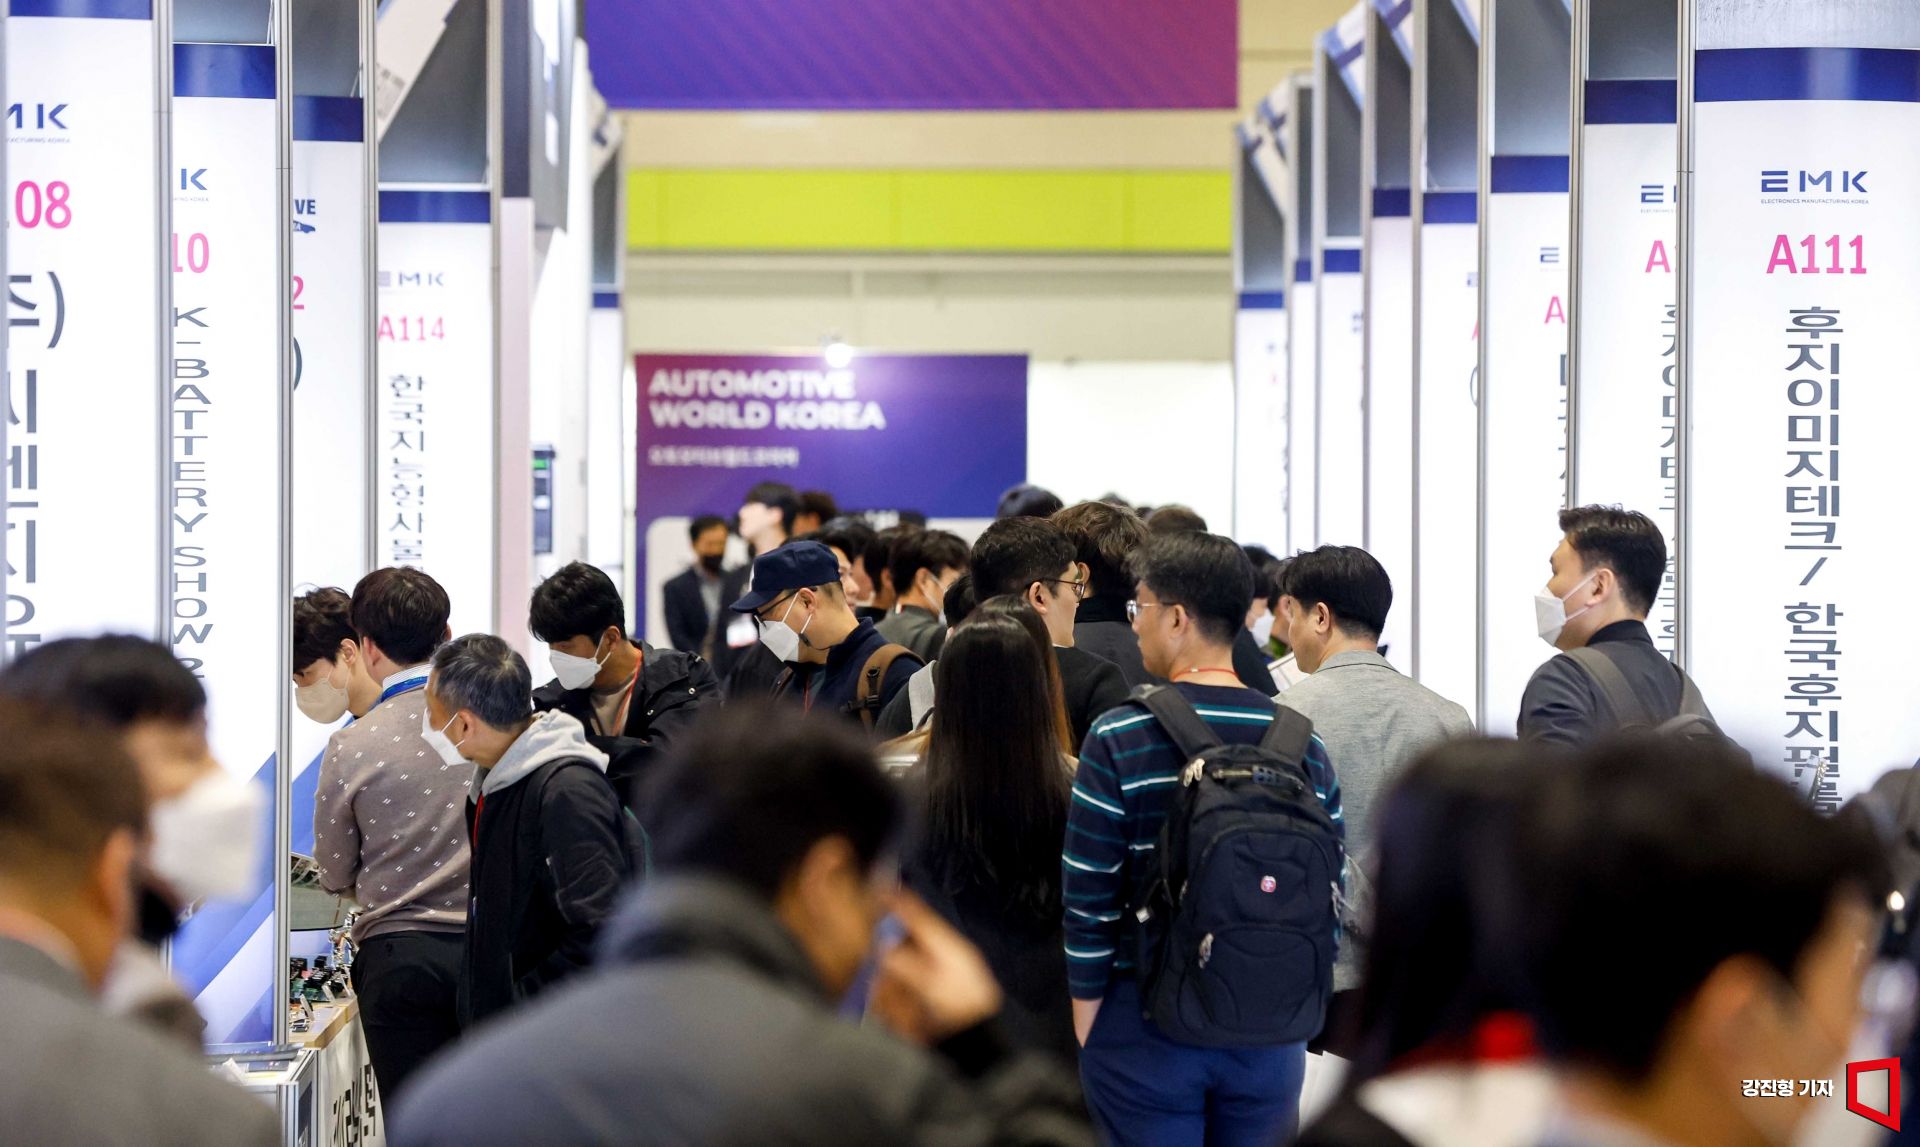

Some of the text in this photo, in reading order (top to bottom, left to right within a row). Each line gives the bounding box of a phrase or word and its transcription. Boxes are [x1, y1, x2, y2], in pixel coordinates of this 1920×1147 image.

[1761, 171, 1868, 193] EMK
[7, 180, 72, 229] 08
[294, 199, 316, 215] VE
[173, 232, 210, 273] 10
[1766, 234, 1868, 275] A111
[377, 315, 445, 341] A114
[648, 368, 857, 399] AUTOMOTIVE
[648, 400, 887, 431] WORLD KOREA
[173, 546, 214, 645] SHOW
